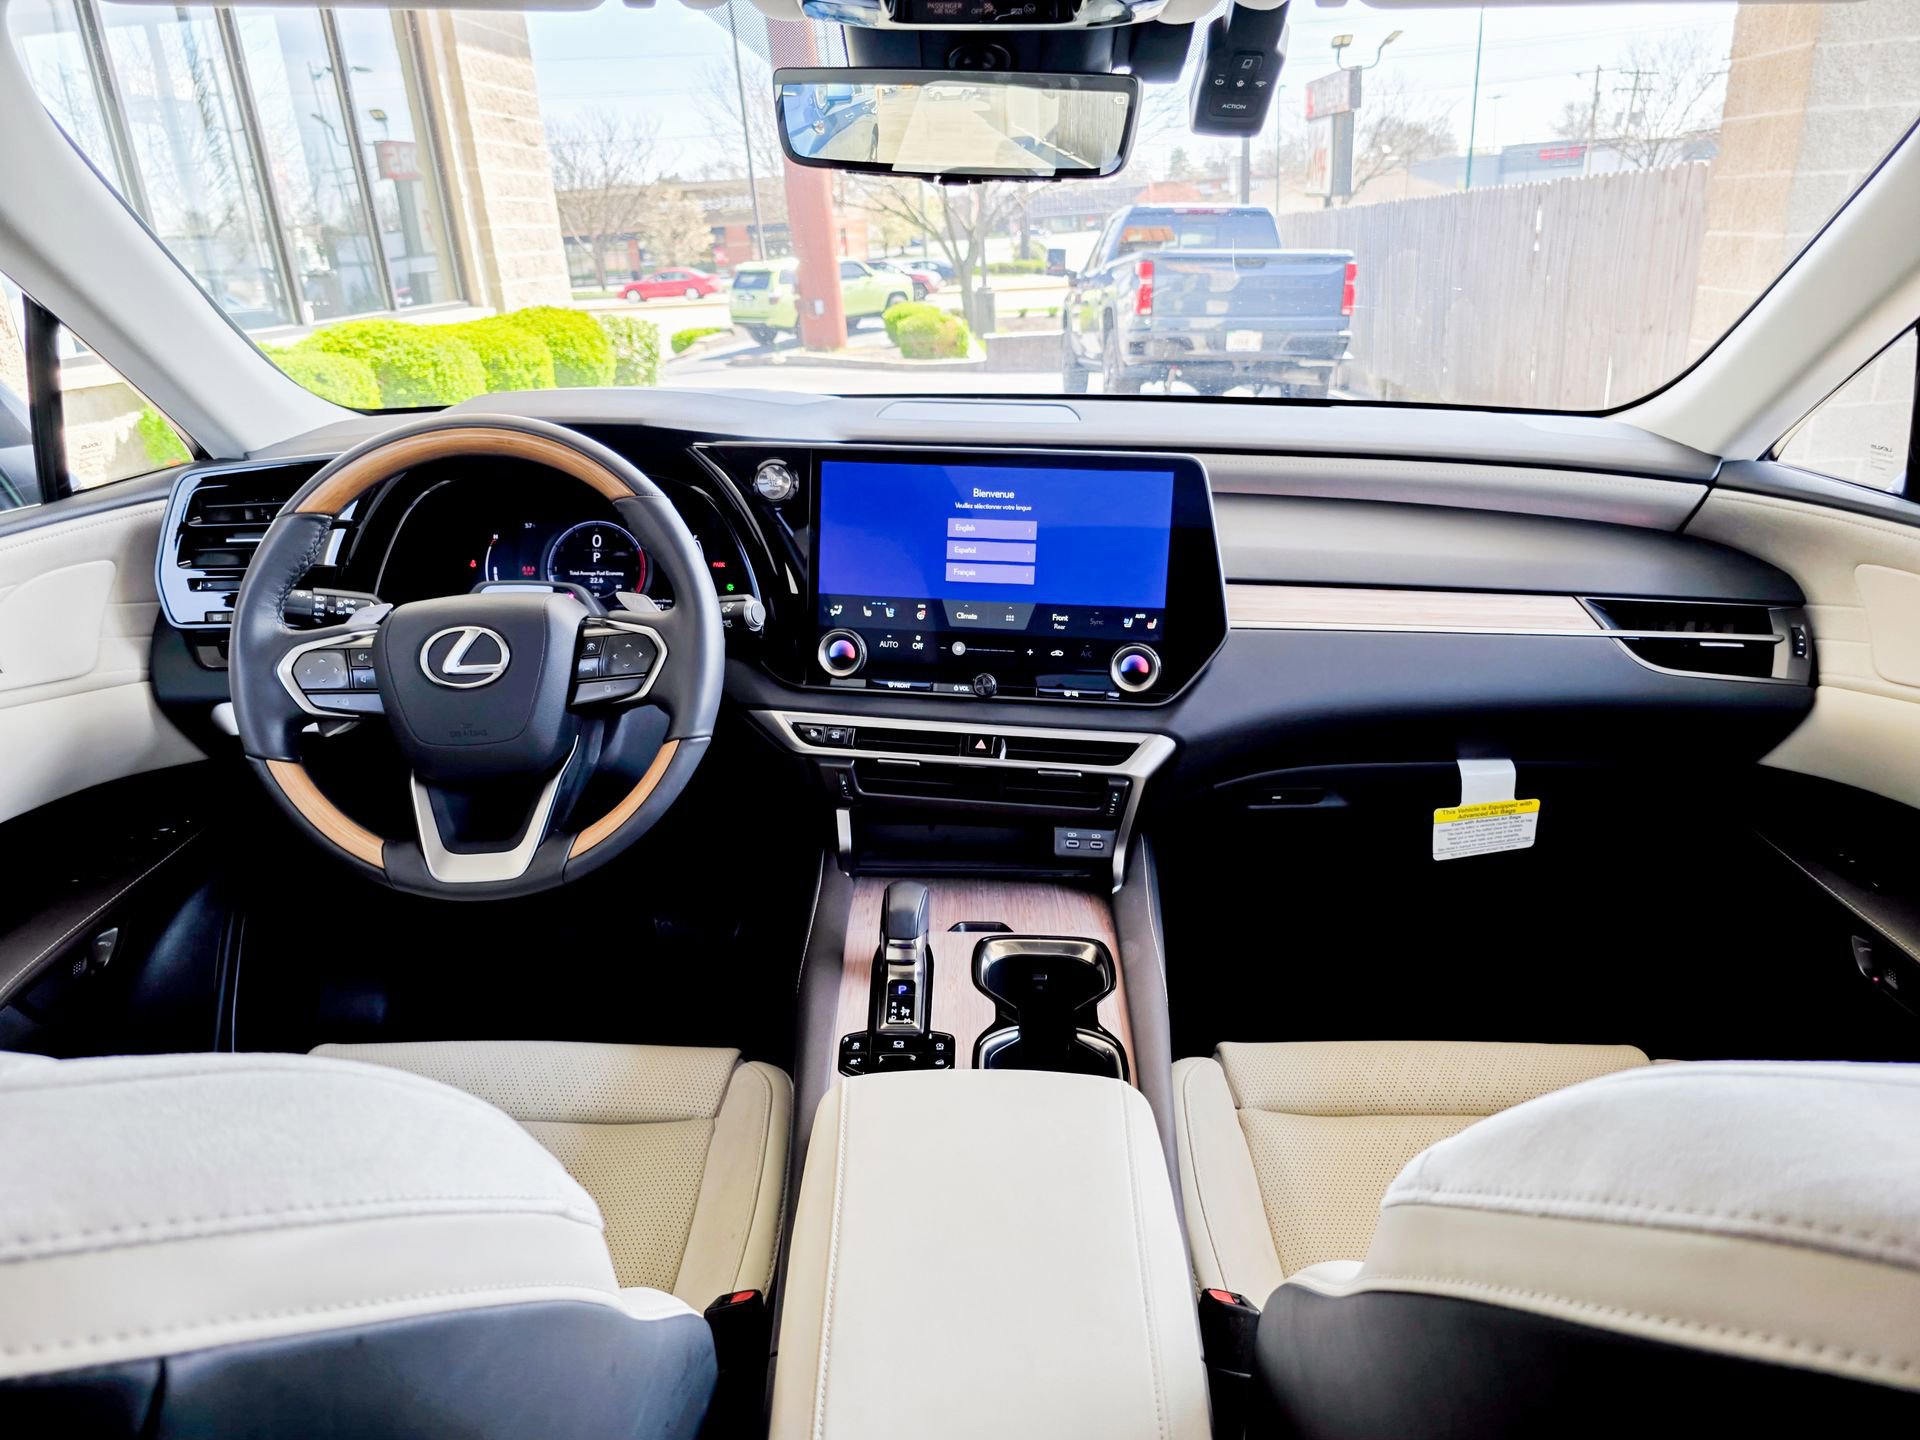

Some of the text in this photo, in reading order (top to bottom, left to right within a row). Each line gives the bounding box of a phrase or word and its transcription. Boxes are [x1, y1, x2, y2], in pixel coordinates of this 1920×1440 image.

[972, 488, 1015, 499] Bienvenue
[955, 524, 976, 532] English
[592, 534, 602, 548] 0
[954, 546, 976, 554] Español
[593, 552, 600, 562] P
[953, 568, 976, 576] Français
[956, 612, 978, 620] Climate
[1052, 613, 1068, 622] Front
[1090, 618, 1104, 626] Sync
[1488, 803, 1518, 811] Equipped
[898, 985, 907, 994] P
